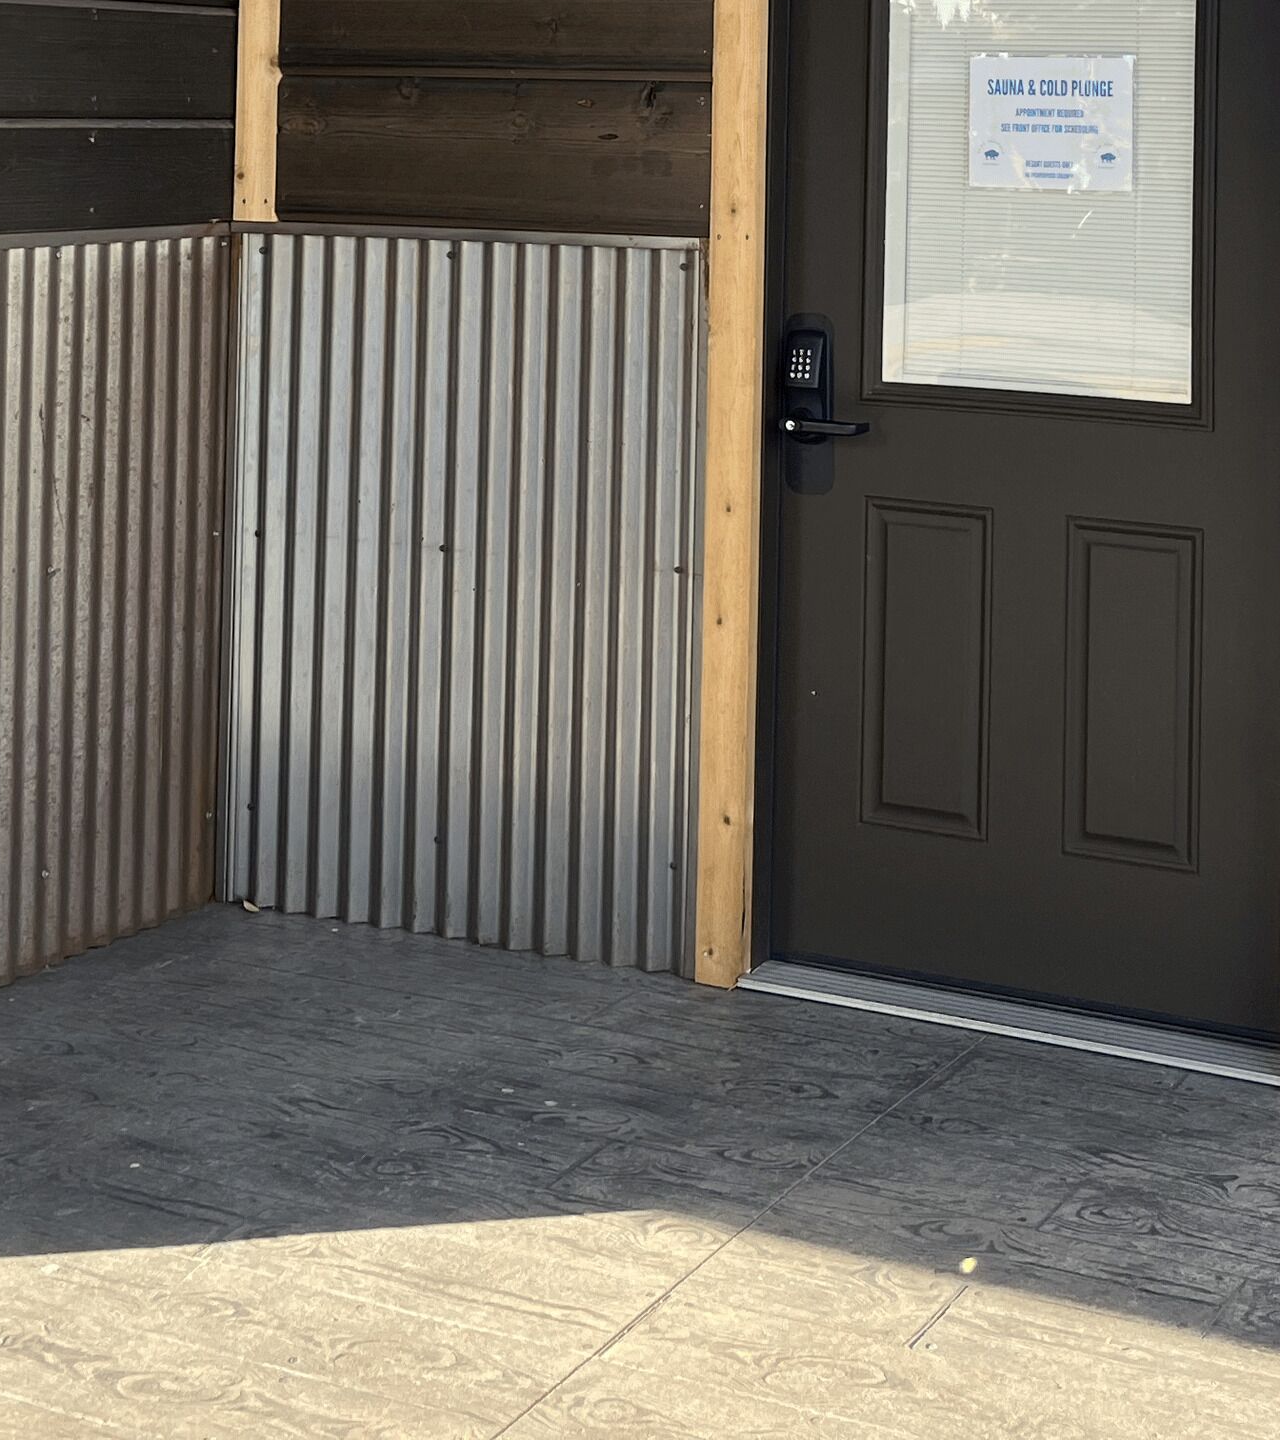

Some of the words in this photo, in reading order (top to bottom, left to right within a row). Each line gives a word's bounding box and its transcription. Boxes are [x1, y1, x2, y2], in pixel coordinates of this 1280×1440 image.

[987, 78, 1025, 96] SAUNA
[1027, 79, 1036, 96] &
[1039, 79, 1068, 97] COLD
[1071, 80, 1114, 97] PLUNGE
[1015, 108, 1055, 118] APPOINTMENT
[1001, 123, 1011, 133] SEE
[1012, 123, 1030, 133] FRONT
[1031, 124, 1050, 133] OFFICE
